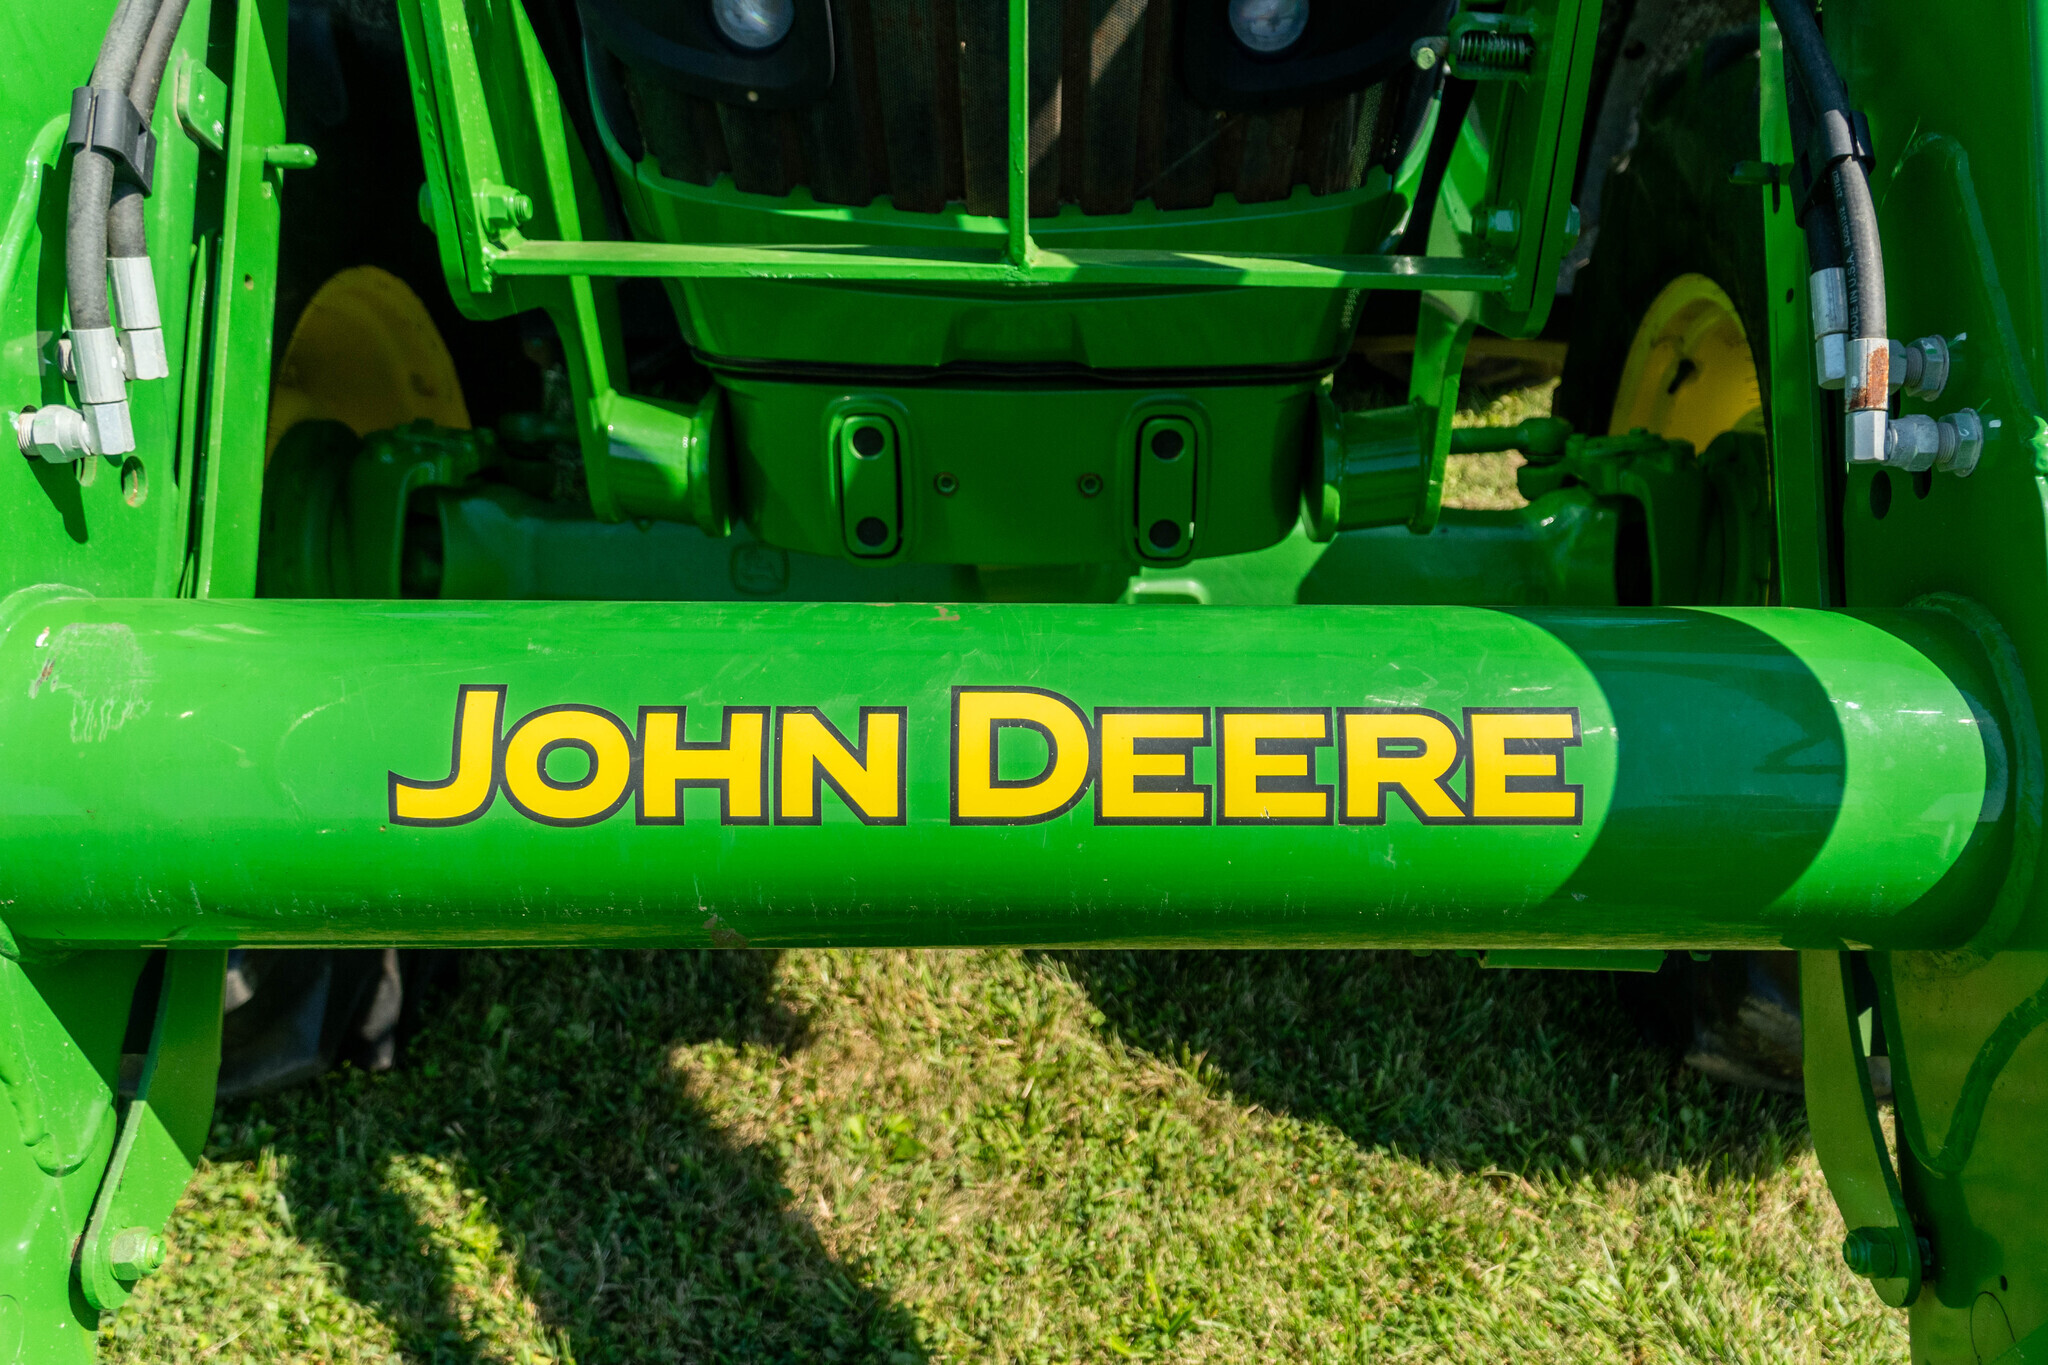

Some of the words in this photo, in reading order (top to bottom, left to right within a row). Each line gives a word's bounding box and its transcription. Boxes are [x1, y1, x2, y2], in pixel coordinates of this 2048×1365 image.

[1846, 251, 1857, 288] U.S.A.
[1849, 289, 1859, 305] IN
[1850, 306, 1860, 338] MADE
[388, 684, 907, 827] JOHN
[950, 685, 1583, 826] DEERE
